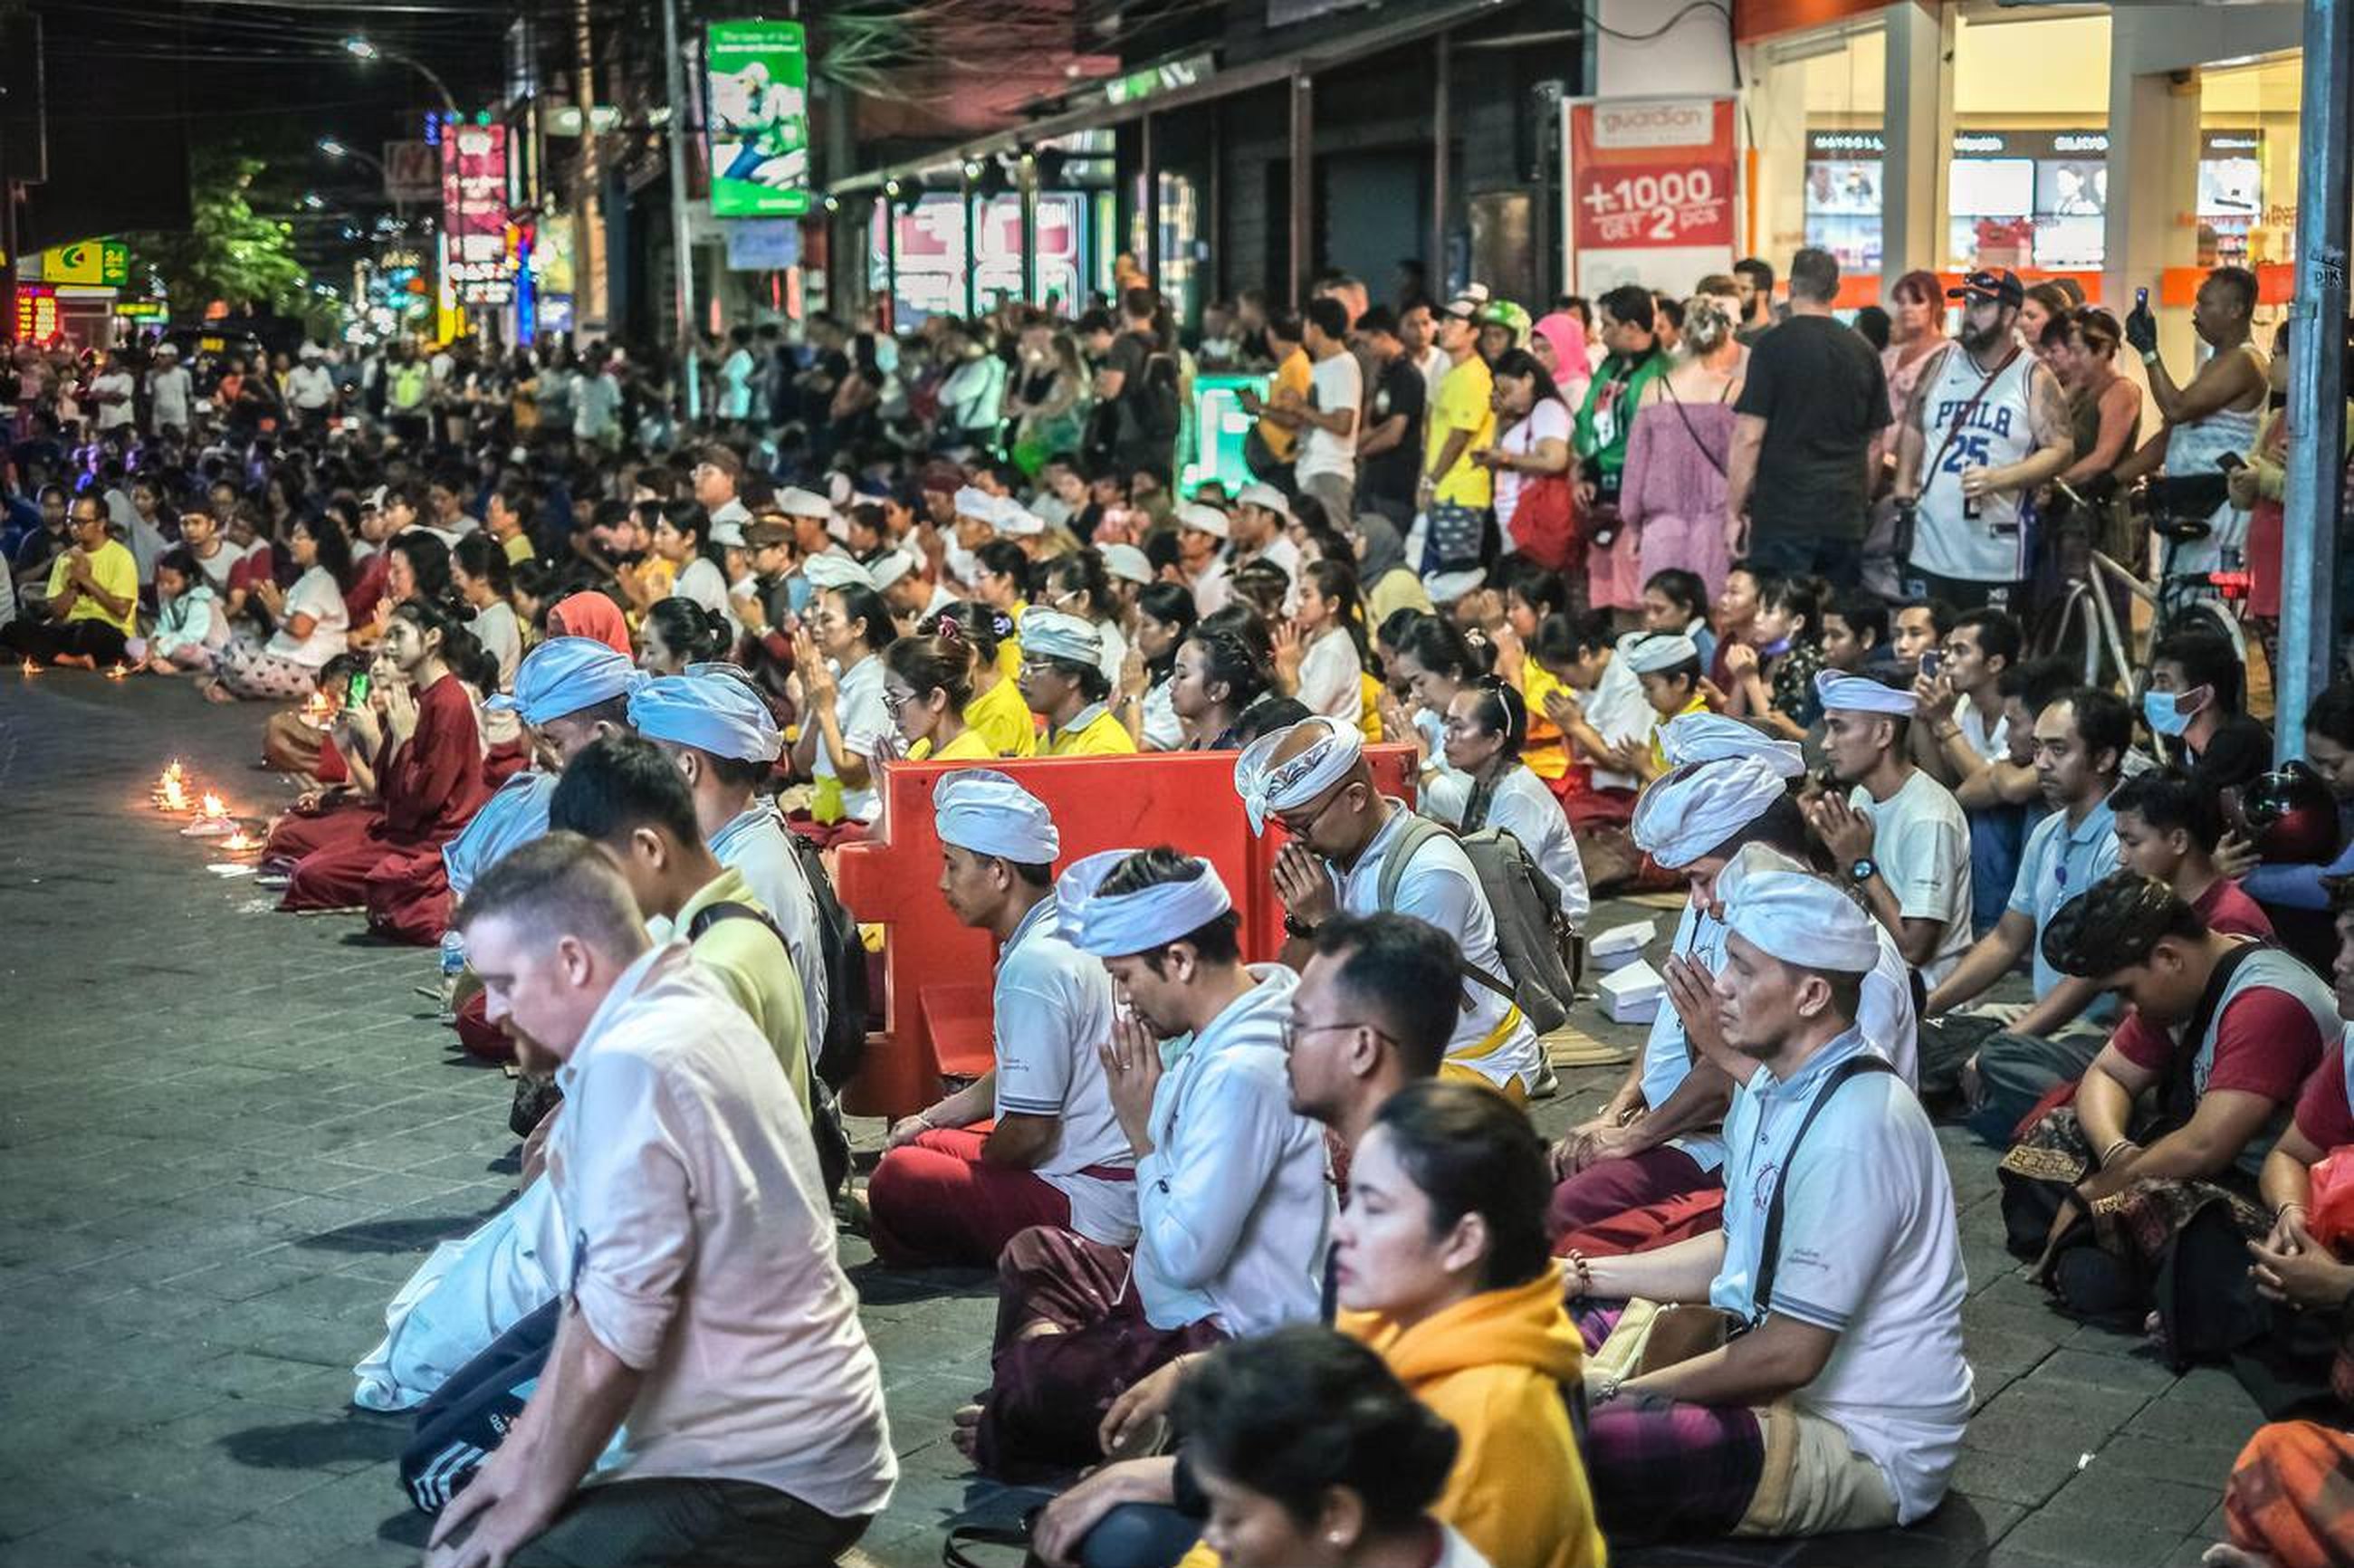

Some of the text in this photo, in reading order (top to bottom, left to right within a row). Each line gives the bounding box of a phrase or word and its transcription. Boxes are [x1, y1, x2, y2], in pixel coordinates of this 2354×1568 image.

[1603, 108, 1702, 133] guardian
[1599, 214, 1641, 242] GET
[1649, 205, 1678, 240] 2
[1935, 400, 2012, 438] PHILA
[1942, 435, 1990, 473] 25
